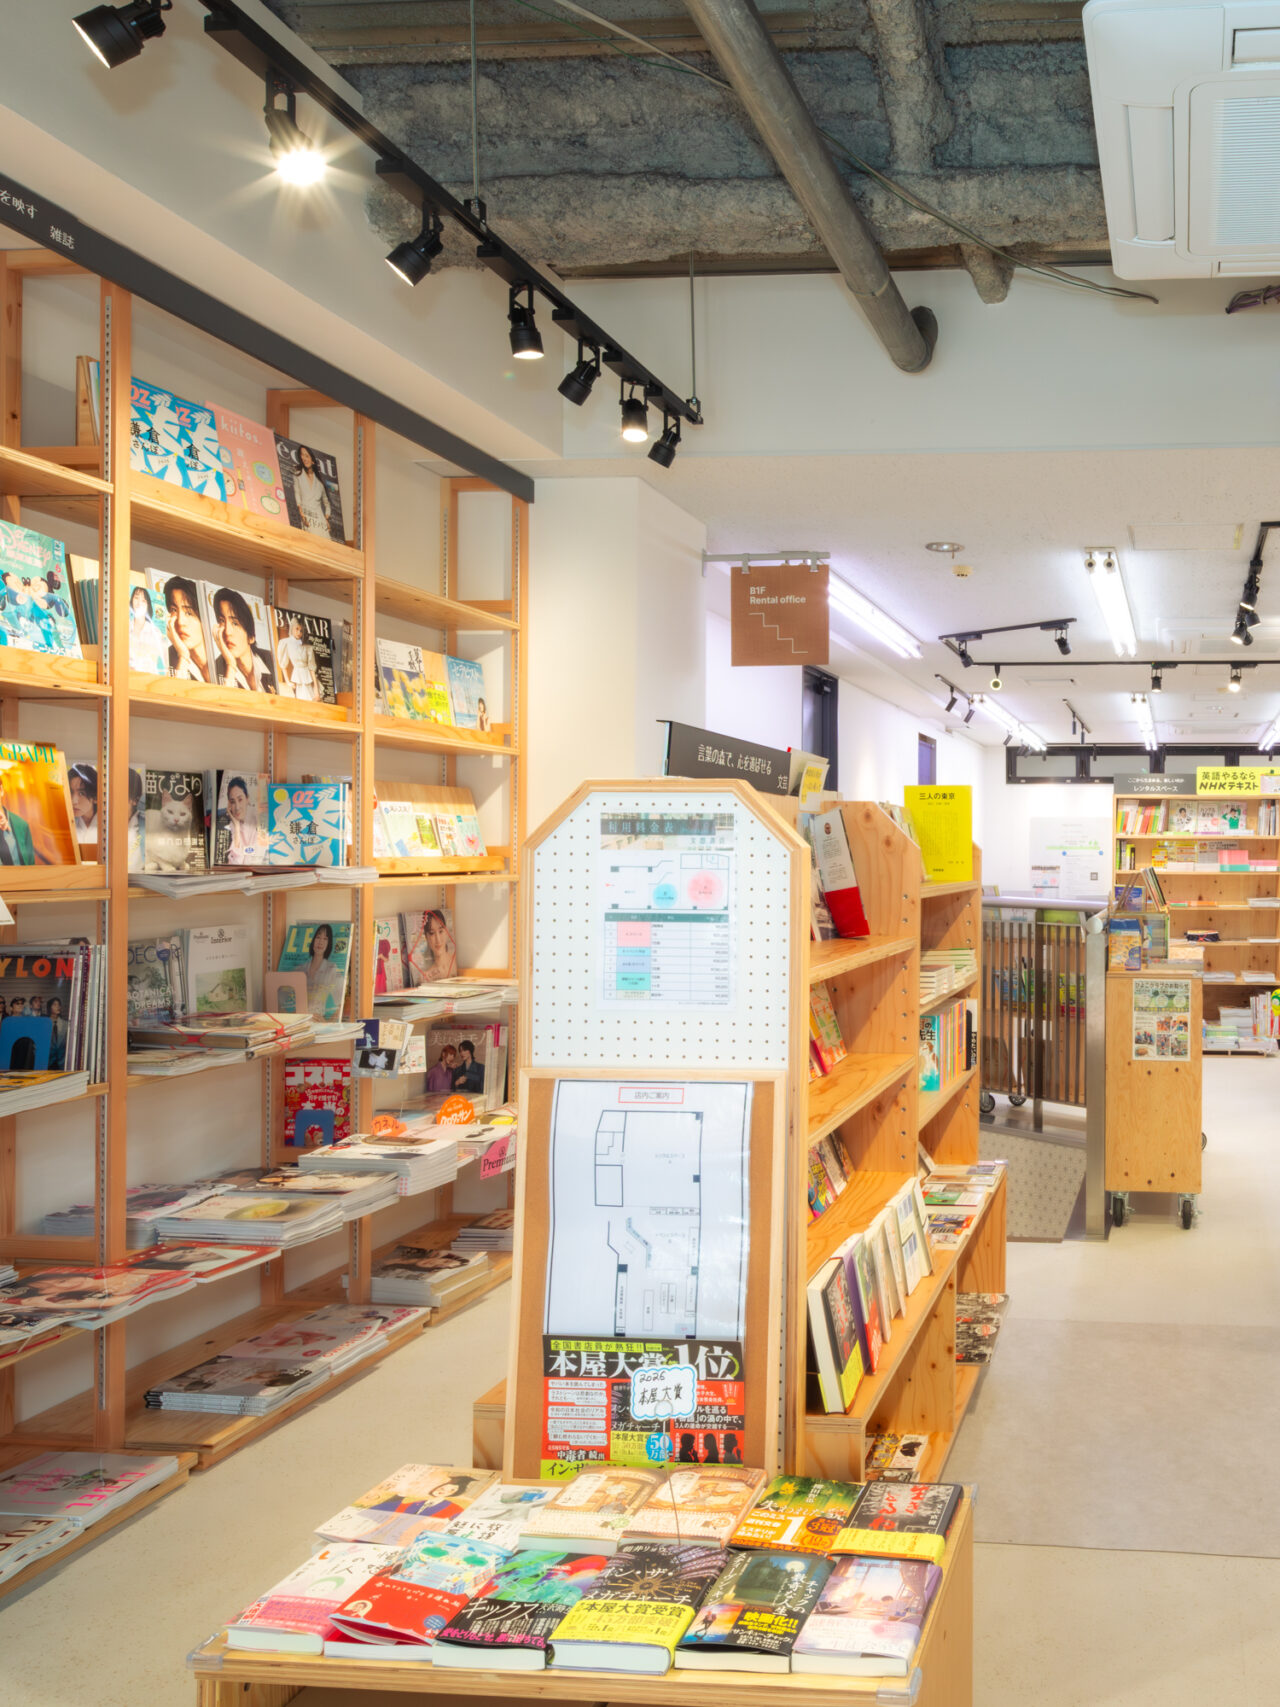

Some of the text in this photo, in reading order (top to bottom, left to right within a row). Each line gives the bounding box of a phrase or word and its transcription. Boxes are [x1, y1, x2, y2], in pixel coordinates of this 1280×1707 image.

[50, 225, 75, 250] 雑誌
[750, 586, 767, 595] B1F
[750, 595, 806, 605] Rental office
[777, 775, 789, 790] 文芸
[1201, 771, 1257, 781] 英語やるなら
[1133, 785, 1179, 793] レンタルスペース
[1199, 781, 1259, 791] NHKテキスト
[919, 792, 956, 801] 三人の東京
[289, 820, 319, 836] 鎌倉
[674, 1343, 735, 1381] 1位
[639, 1370, 665, 1383] 2026
[638, 1384, 684, 1405] 本屋大賞
[649, 1435, 670, 1450] 50
[461, 1597, 542, 1621] キックス
[584, 1601, 687, 1619] 本屋大賞受賞
[742, 1610, 799, 1629] 映画化!!
